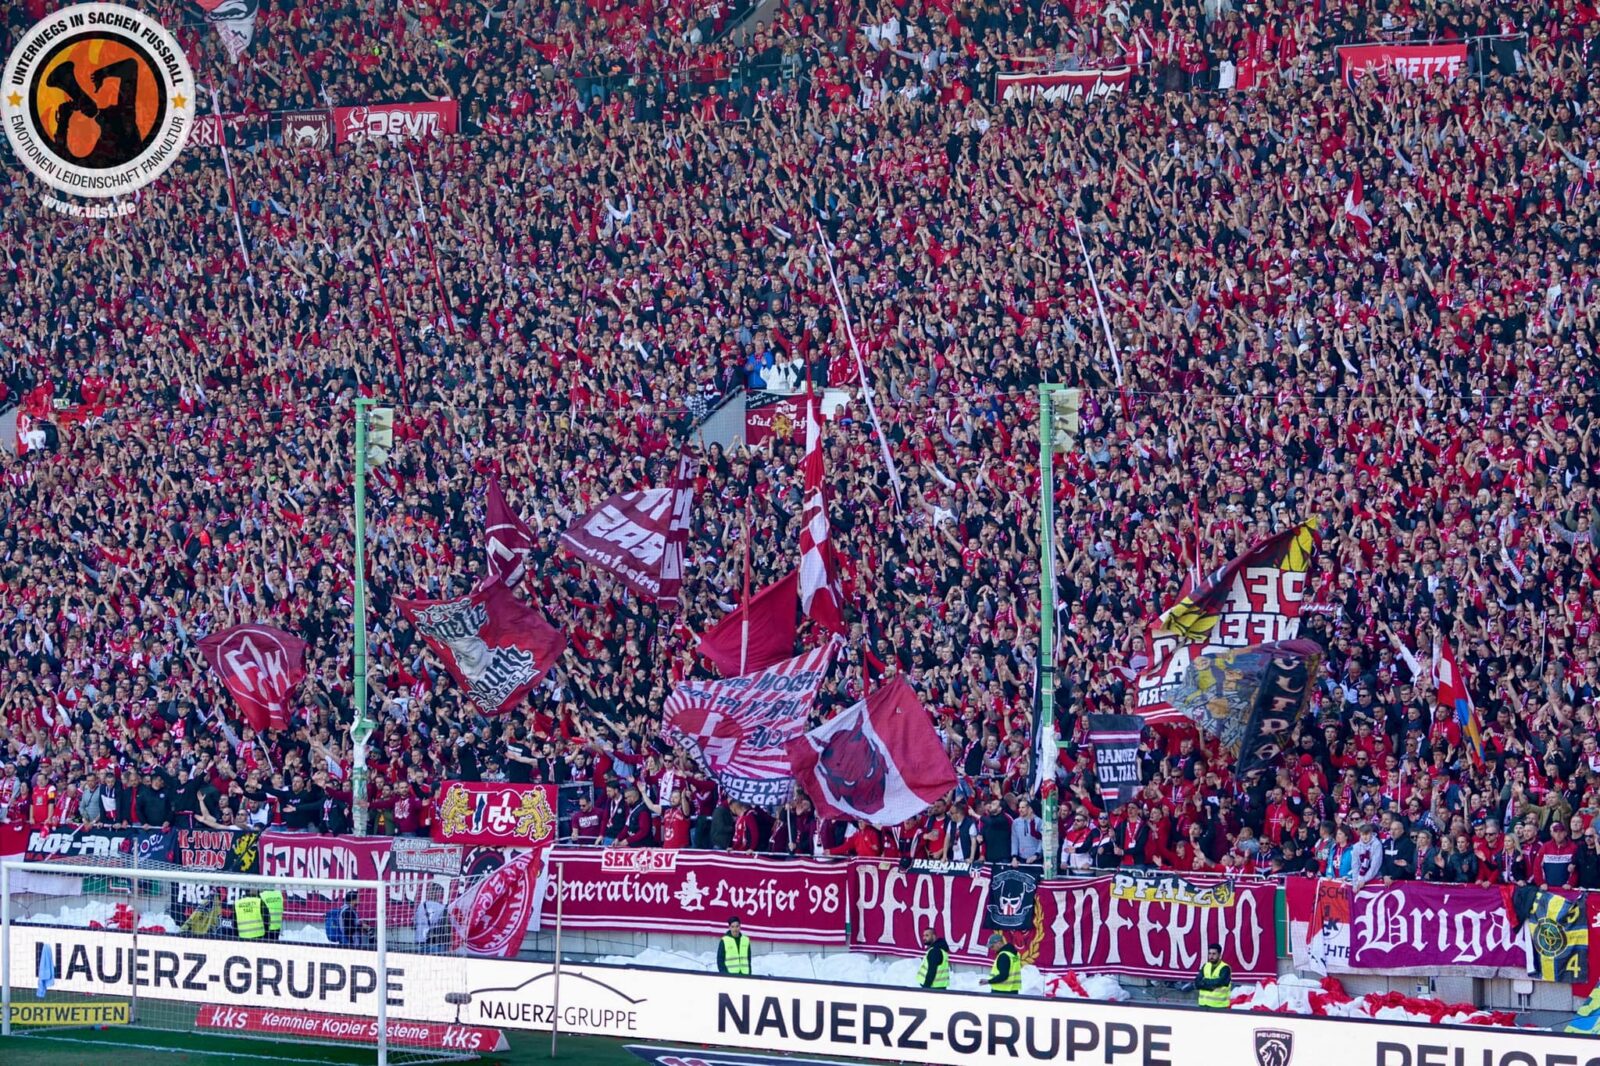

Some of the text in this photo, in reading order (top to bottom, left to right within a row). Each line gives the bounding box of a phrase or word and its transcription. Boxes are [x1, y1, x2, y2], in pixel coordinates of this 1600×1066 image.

[177, 829, 235, 851] K-TOWN
[181, 849, 227, 868] REDS
[604, 851, 674, 869] SEK SV
[912, 858, 970, 872] HASEMANN
[710, 879, 800, 918] Luzifer
[804, 878, 840, 915] '98
[1112, 873, 1212, 906] PFALZ
[855, 863, 991, 958] PFALZ
[1353, 888, 1529, 964] Briga
[35, 940, 404, 1007] NAUERZ-GRUPPE
[0, 1006, 125, 1025] PORTWETTEN
[211, 1006, 483, 1050] kks Kemmler Kopier Ssteme kks
[480, 1001, 637, 1031] NAUERZ-GRUPPE
[717, 992, 1172, 1066] NAUERZ-GRUPPE
[1256, 1032, 1291, 1040] PEUGEOT
